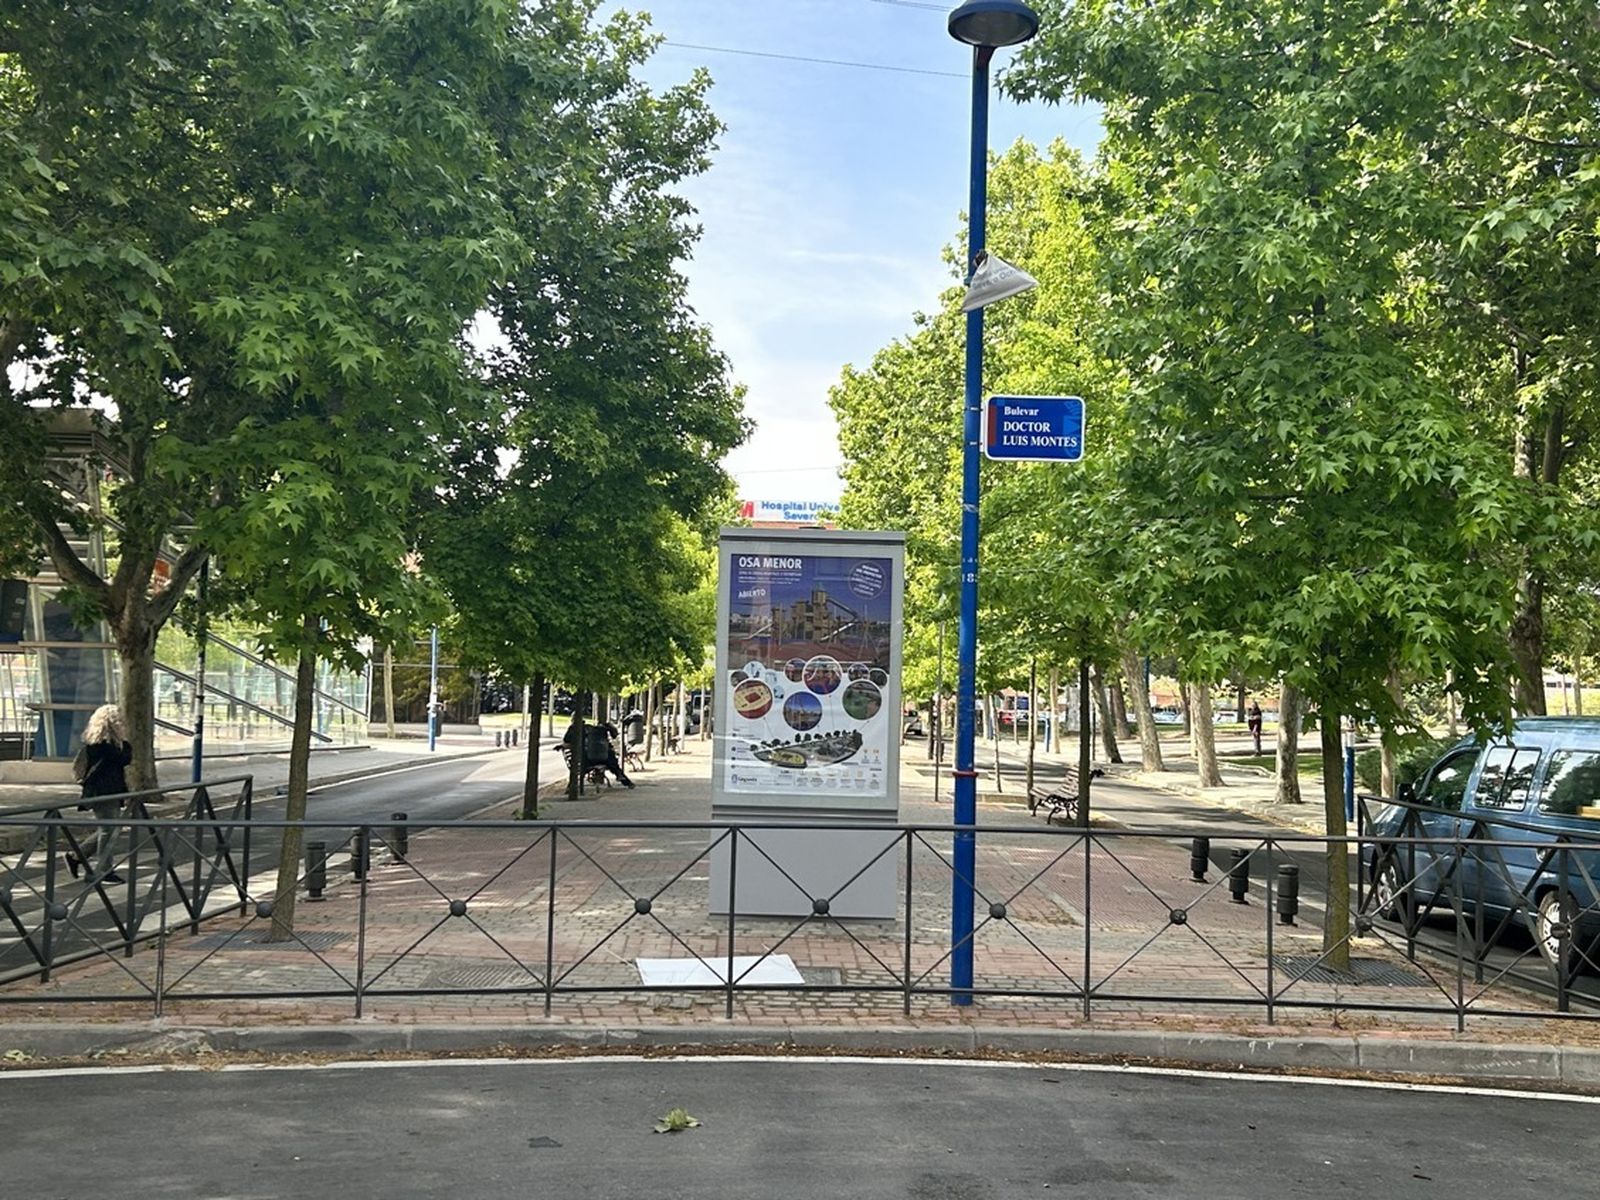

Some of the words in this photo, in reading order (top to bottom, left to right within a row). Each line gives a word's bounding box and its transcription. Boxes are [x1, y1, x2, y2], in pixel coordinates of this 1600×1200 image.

[1004, 406, 1039, 416] Bulevar
[1003, 421, 1051, 432] DOCTOR
[1002, 435, 1028, 446] LUIS
[1030, 436, 1078, 447] MONTES
[761, 500, 807, 511] Hospital
[738, 556, 761, 568] OSA
[763, 557, 802, 569] MENOR
[738, 589, 766, 598] ABIERTO
